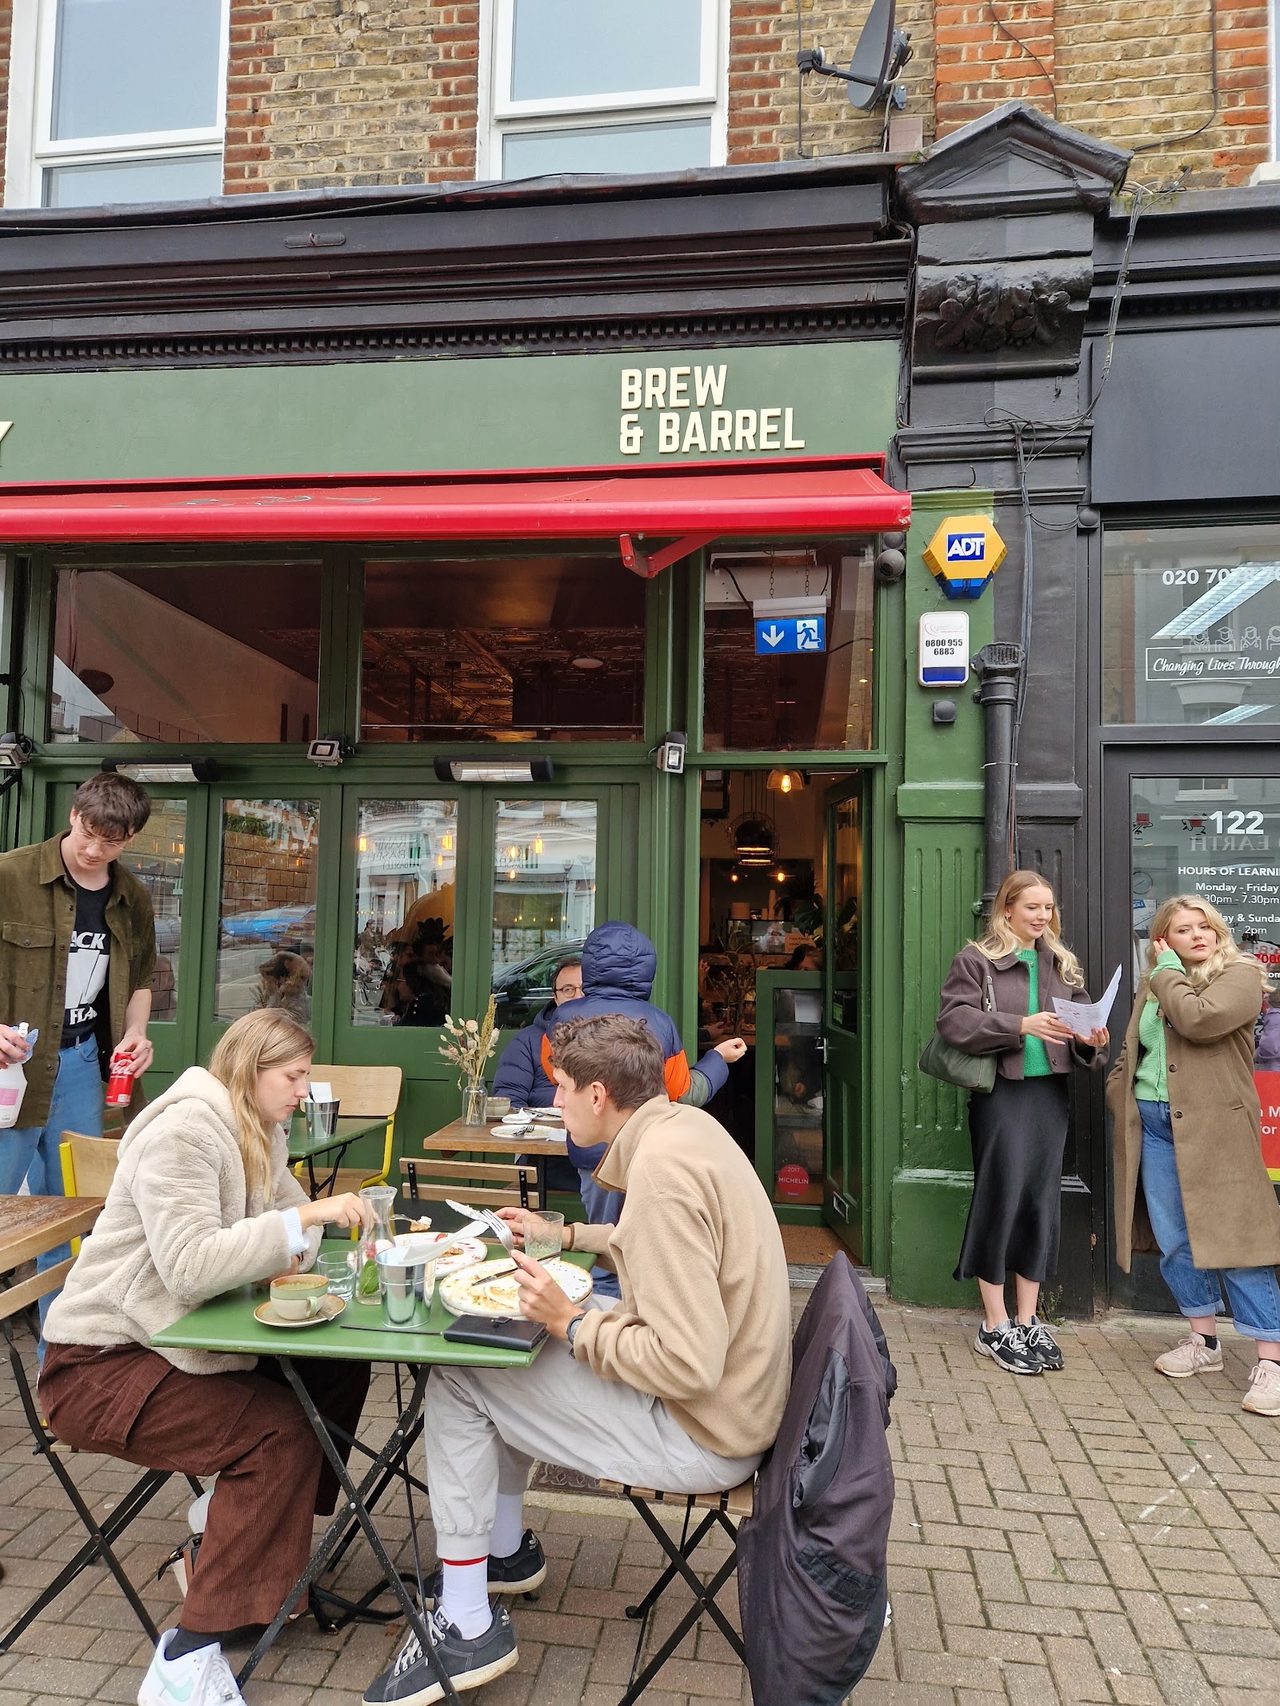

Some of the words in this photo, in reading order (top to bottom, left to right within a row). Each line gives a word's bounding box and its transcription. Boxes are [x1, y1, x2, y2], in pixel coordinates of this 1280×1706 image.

[621, 365, 727, 409] BREW
[620, 414, 644, 454] &
[659, 407, 806, 454] BARREL
[948, 537, 985, 557] ADT
[1162, 569, 1200, 586] 020
[925, 639, 946, 647] 0800
[947, 638, 963, 647] 955
[1153, 658, 1204, 676] Changing
[1208, 657, 1236, 671] Lives
[1209, 810, 1264, 834] 122
[1178, 866, 1217, 875] HOURS
[1220, 867, 1235, 876] OF
[1238, 867, 1280, 876] LEARNI
[1195, 882, 1237, 894] Monday
[1246, 883, 1279, 895] Friday
[1241, 894, 1280, 906] 7.30pm
[1237, 914, 1245, 922] &
[1245, 925, 1267, 936] 2pm
